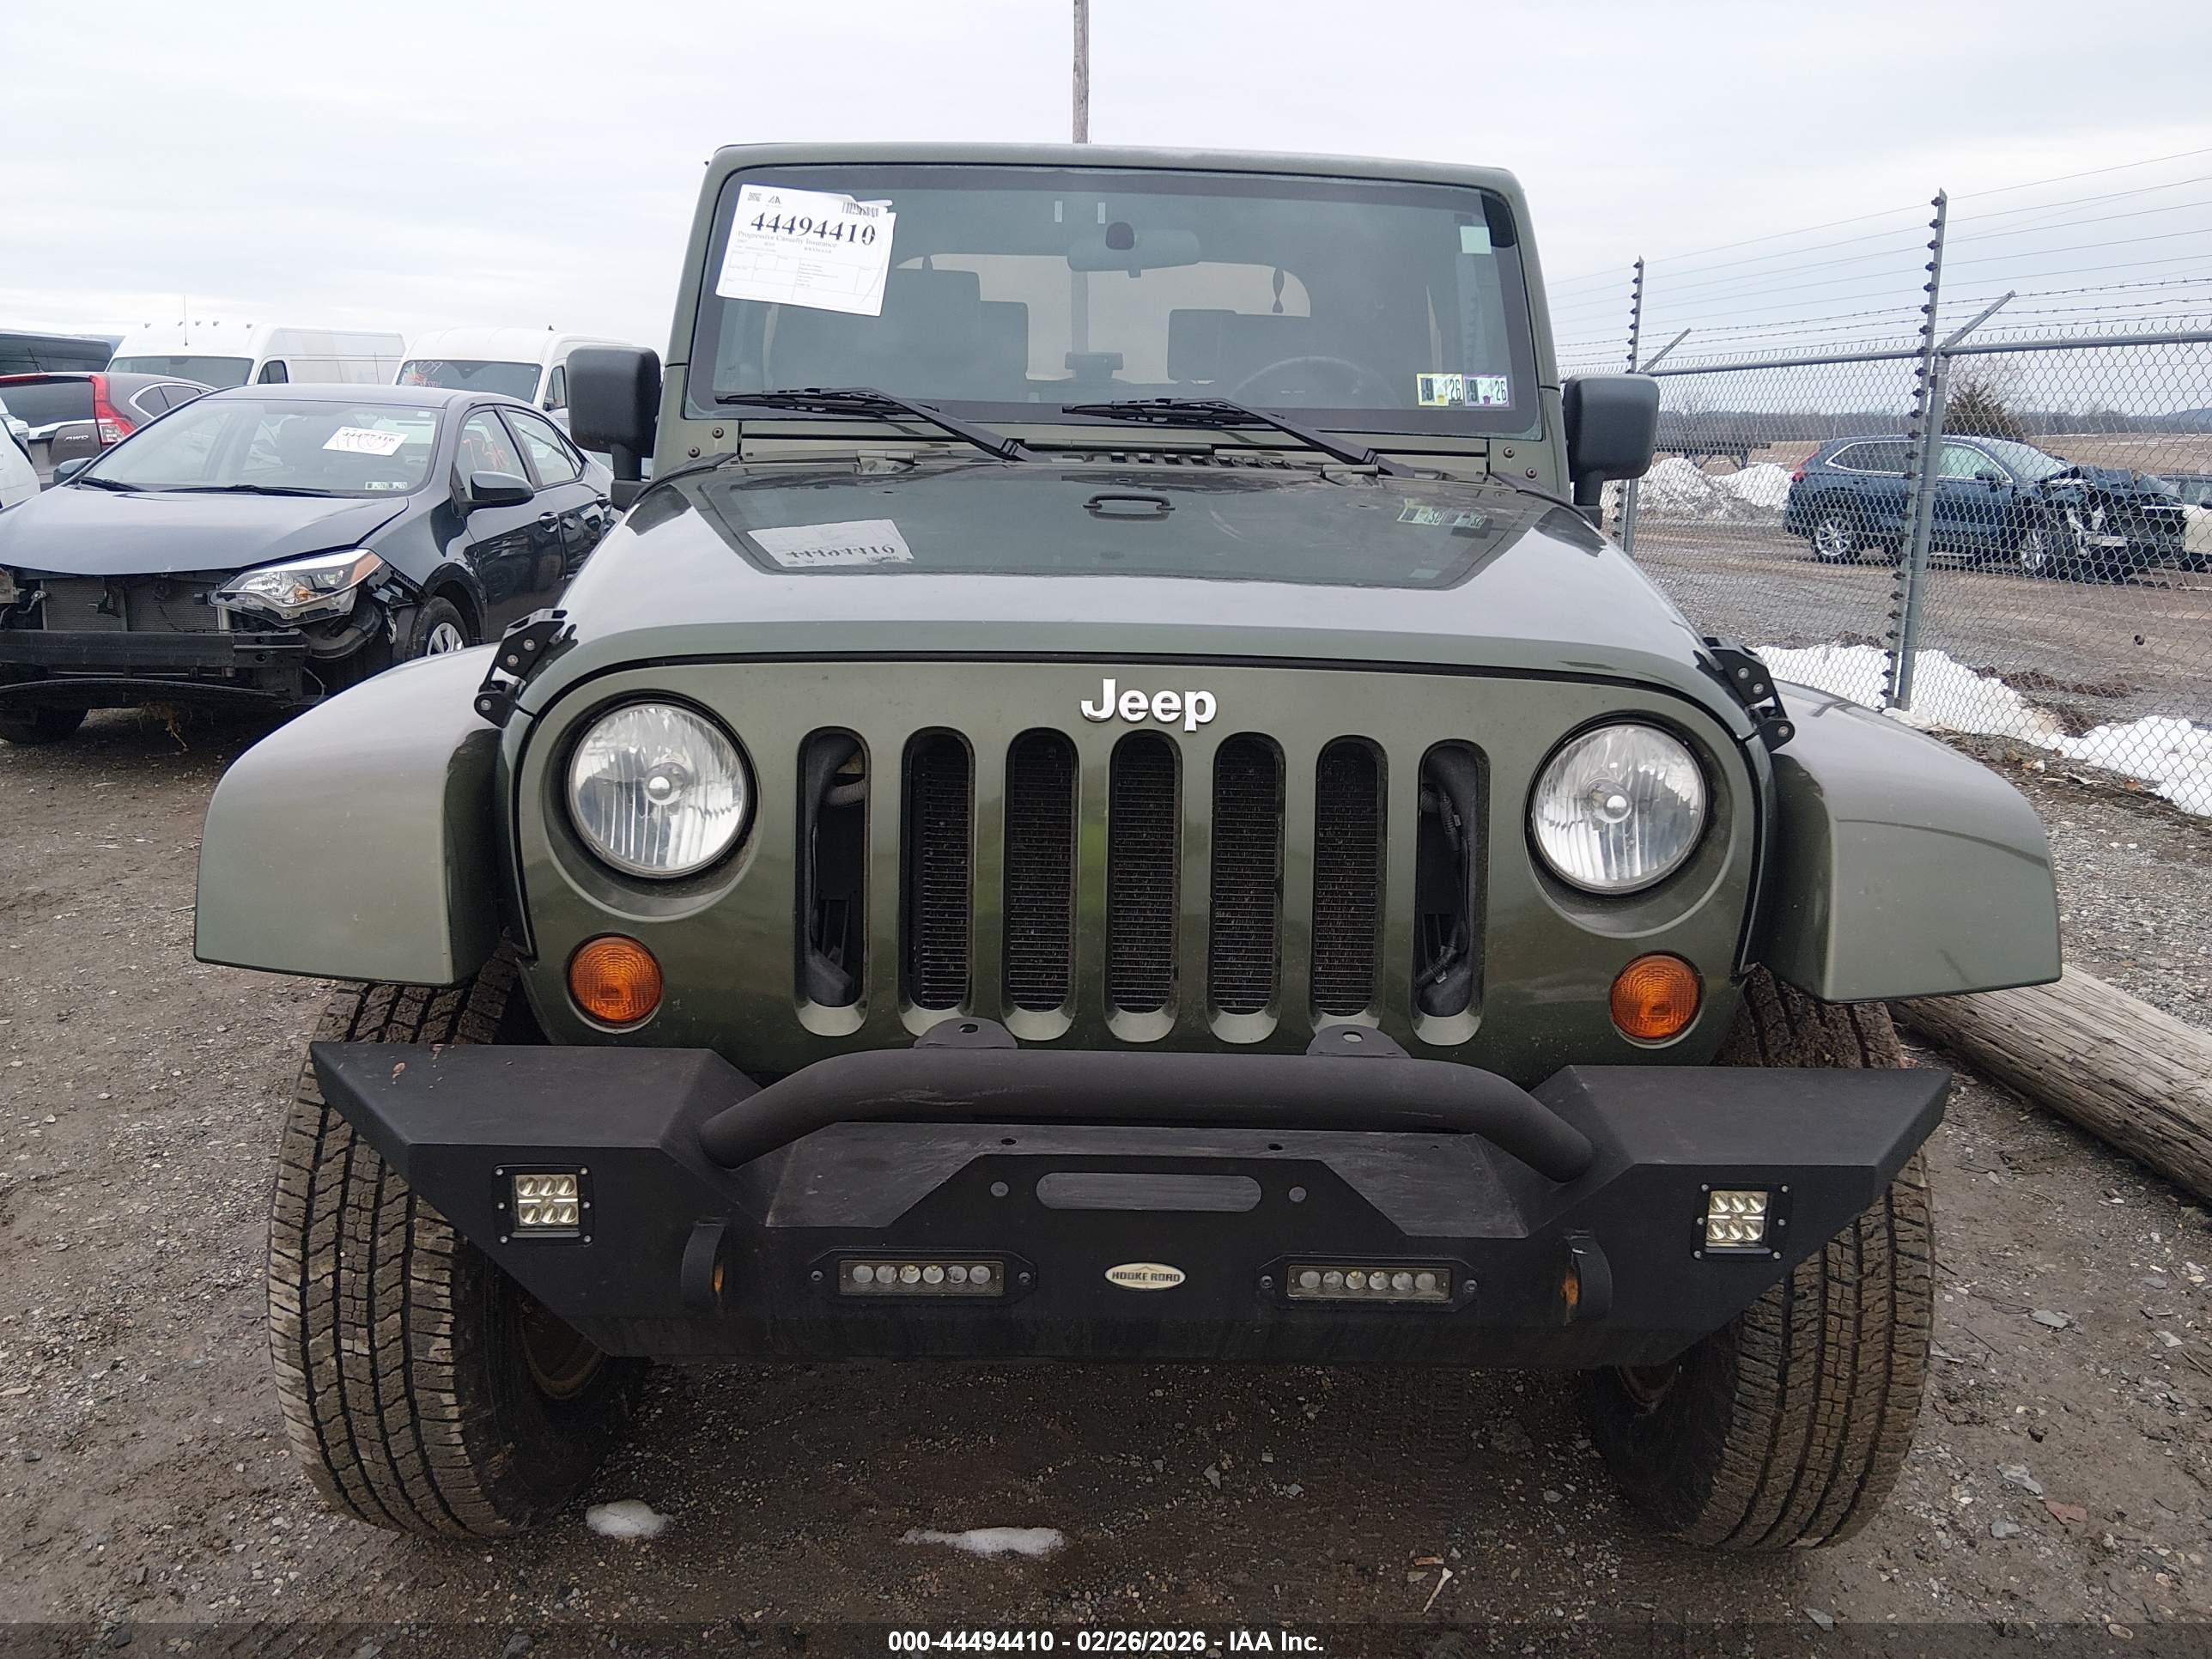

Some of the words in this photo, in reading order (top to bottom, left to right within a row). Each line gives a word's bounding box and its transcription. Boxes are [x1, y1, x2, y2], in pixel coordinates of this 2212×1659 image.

[750, 212, 876, 246] 44494410
[1449, 379, 1461, 400] 26
[1495, 380, 1507, 401] 26
[1080, 678, 1217, 732] Jeep
[1112, 1272, 1148, 1281] HOOKE
[1151, 1273, 1181, 1282] ROAD
